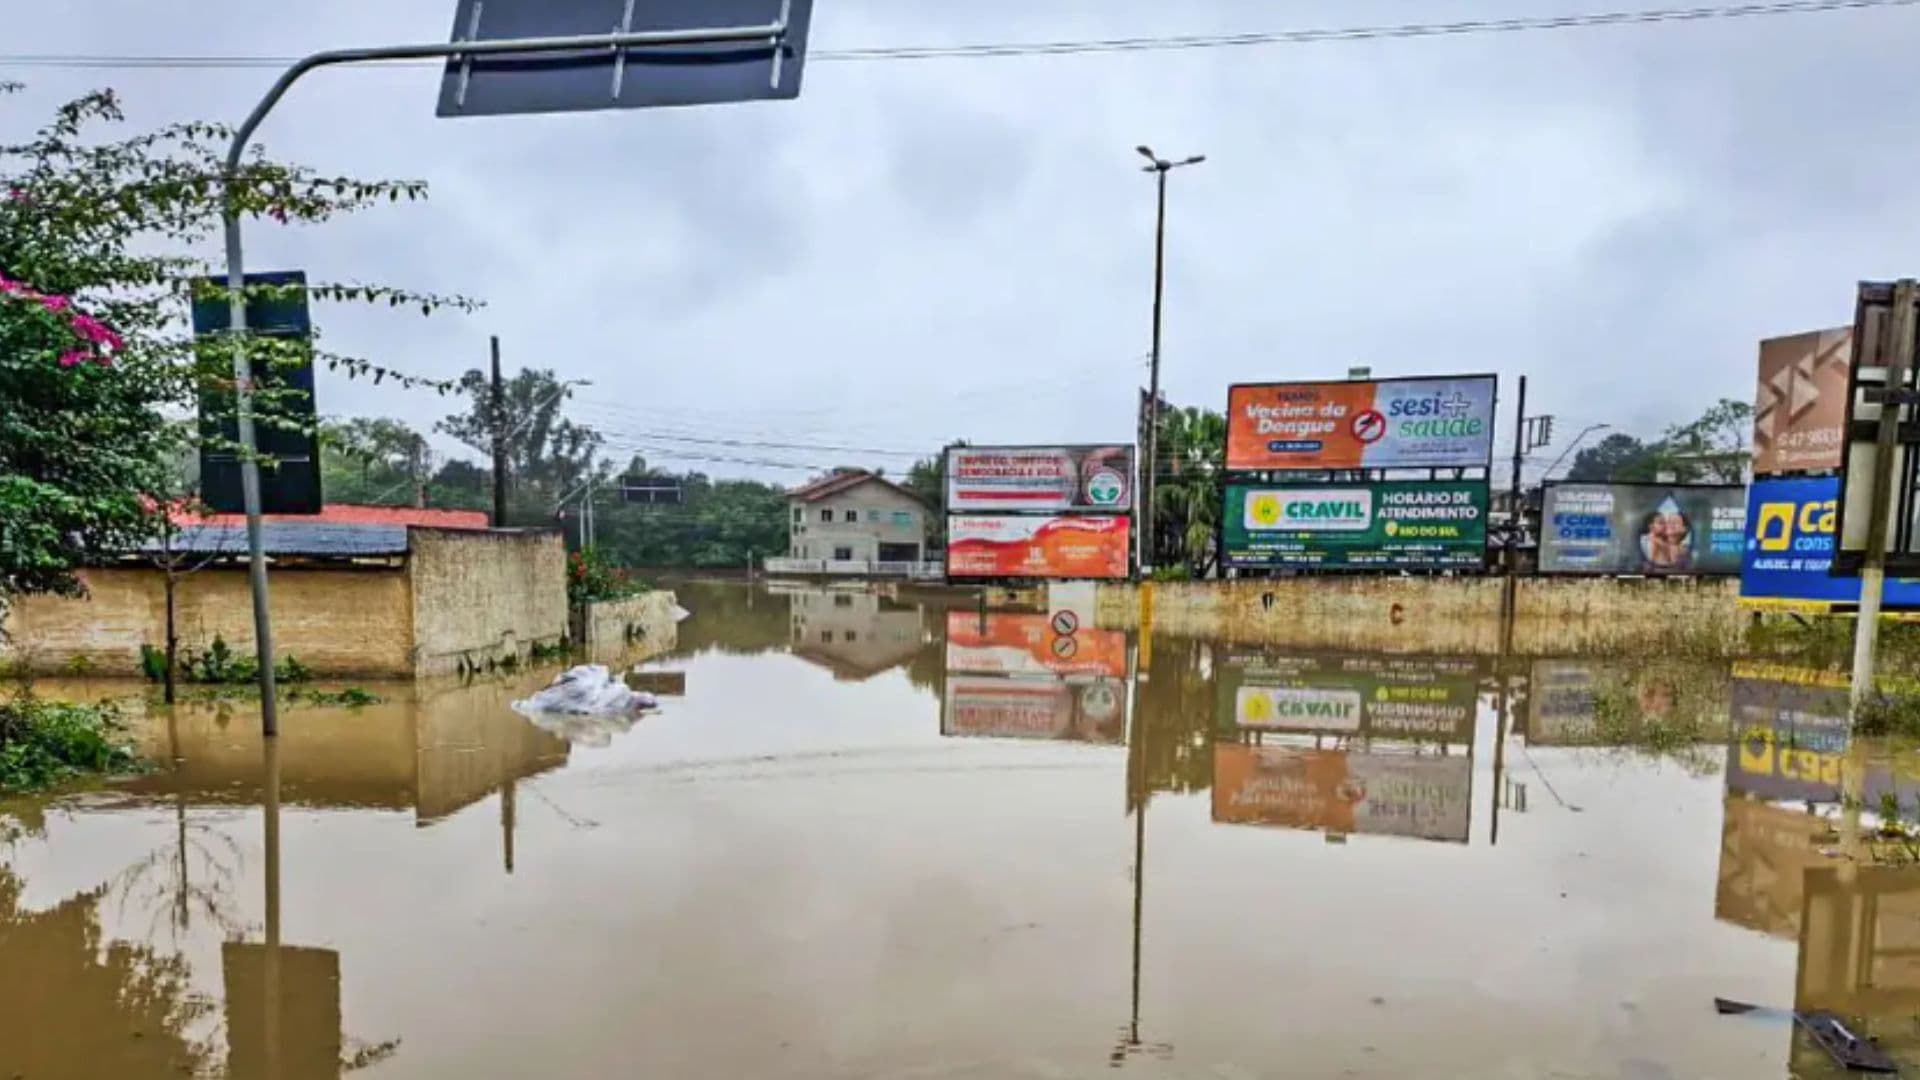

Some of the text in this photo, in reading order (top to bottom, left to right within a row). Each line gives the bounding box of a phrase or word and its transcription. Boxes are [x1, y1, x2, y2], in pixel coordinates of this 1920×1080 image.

[1257, 419, 1335, 438] Dengue
[1453, 491, 1471, 504] DE
[1285, 501, 1365, 518] CRAVIL
[1378, 506, 1478, 519] ATENDIMENTO
[1420, 526, 1437, 537] DO
[1795, 537, 1833, 551] cons
